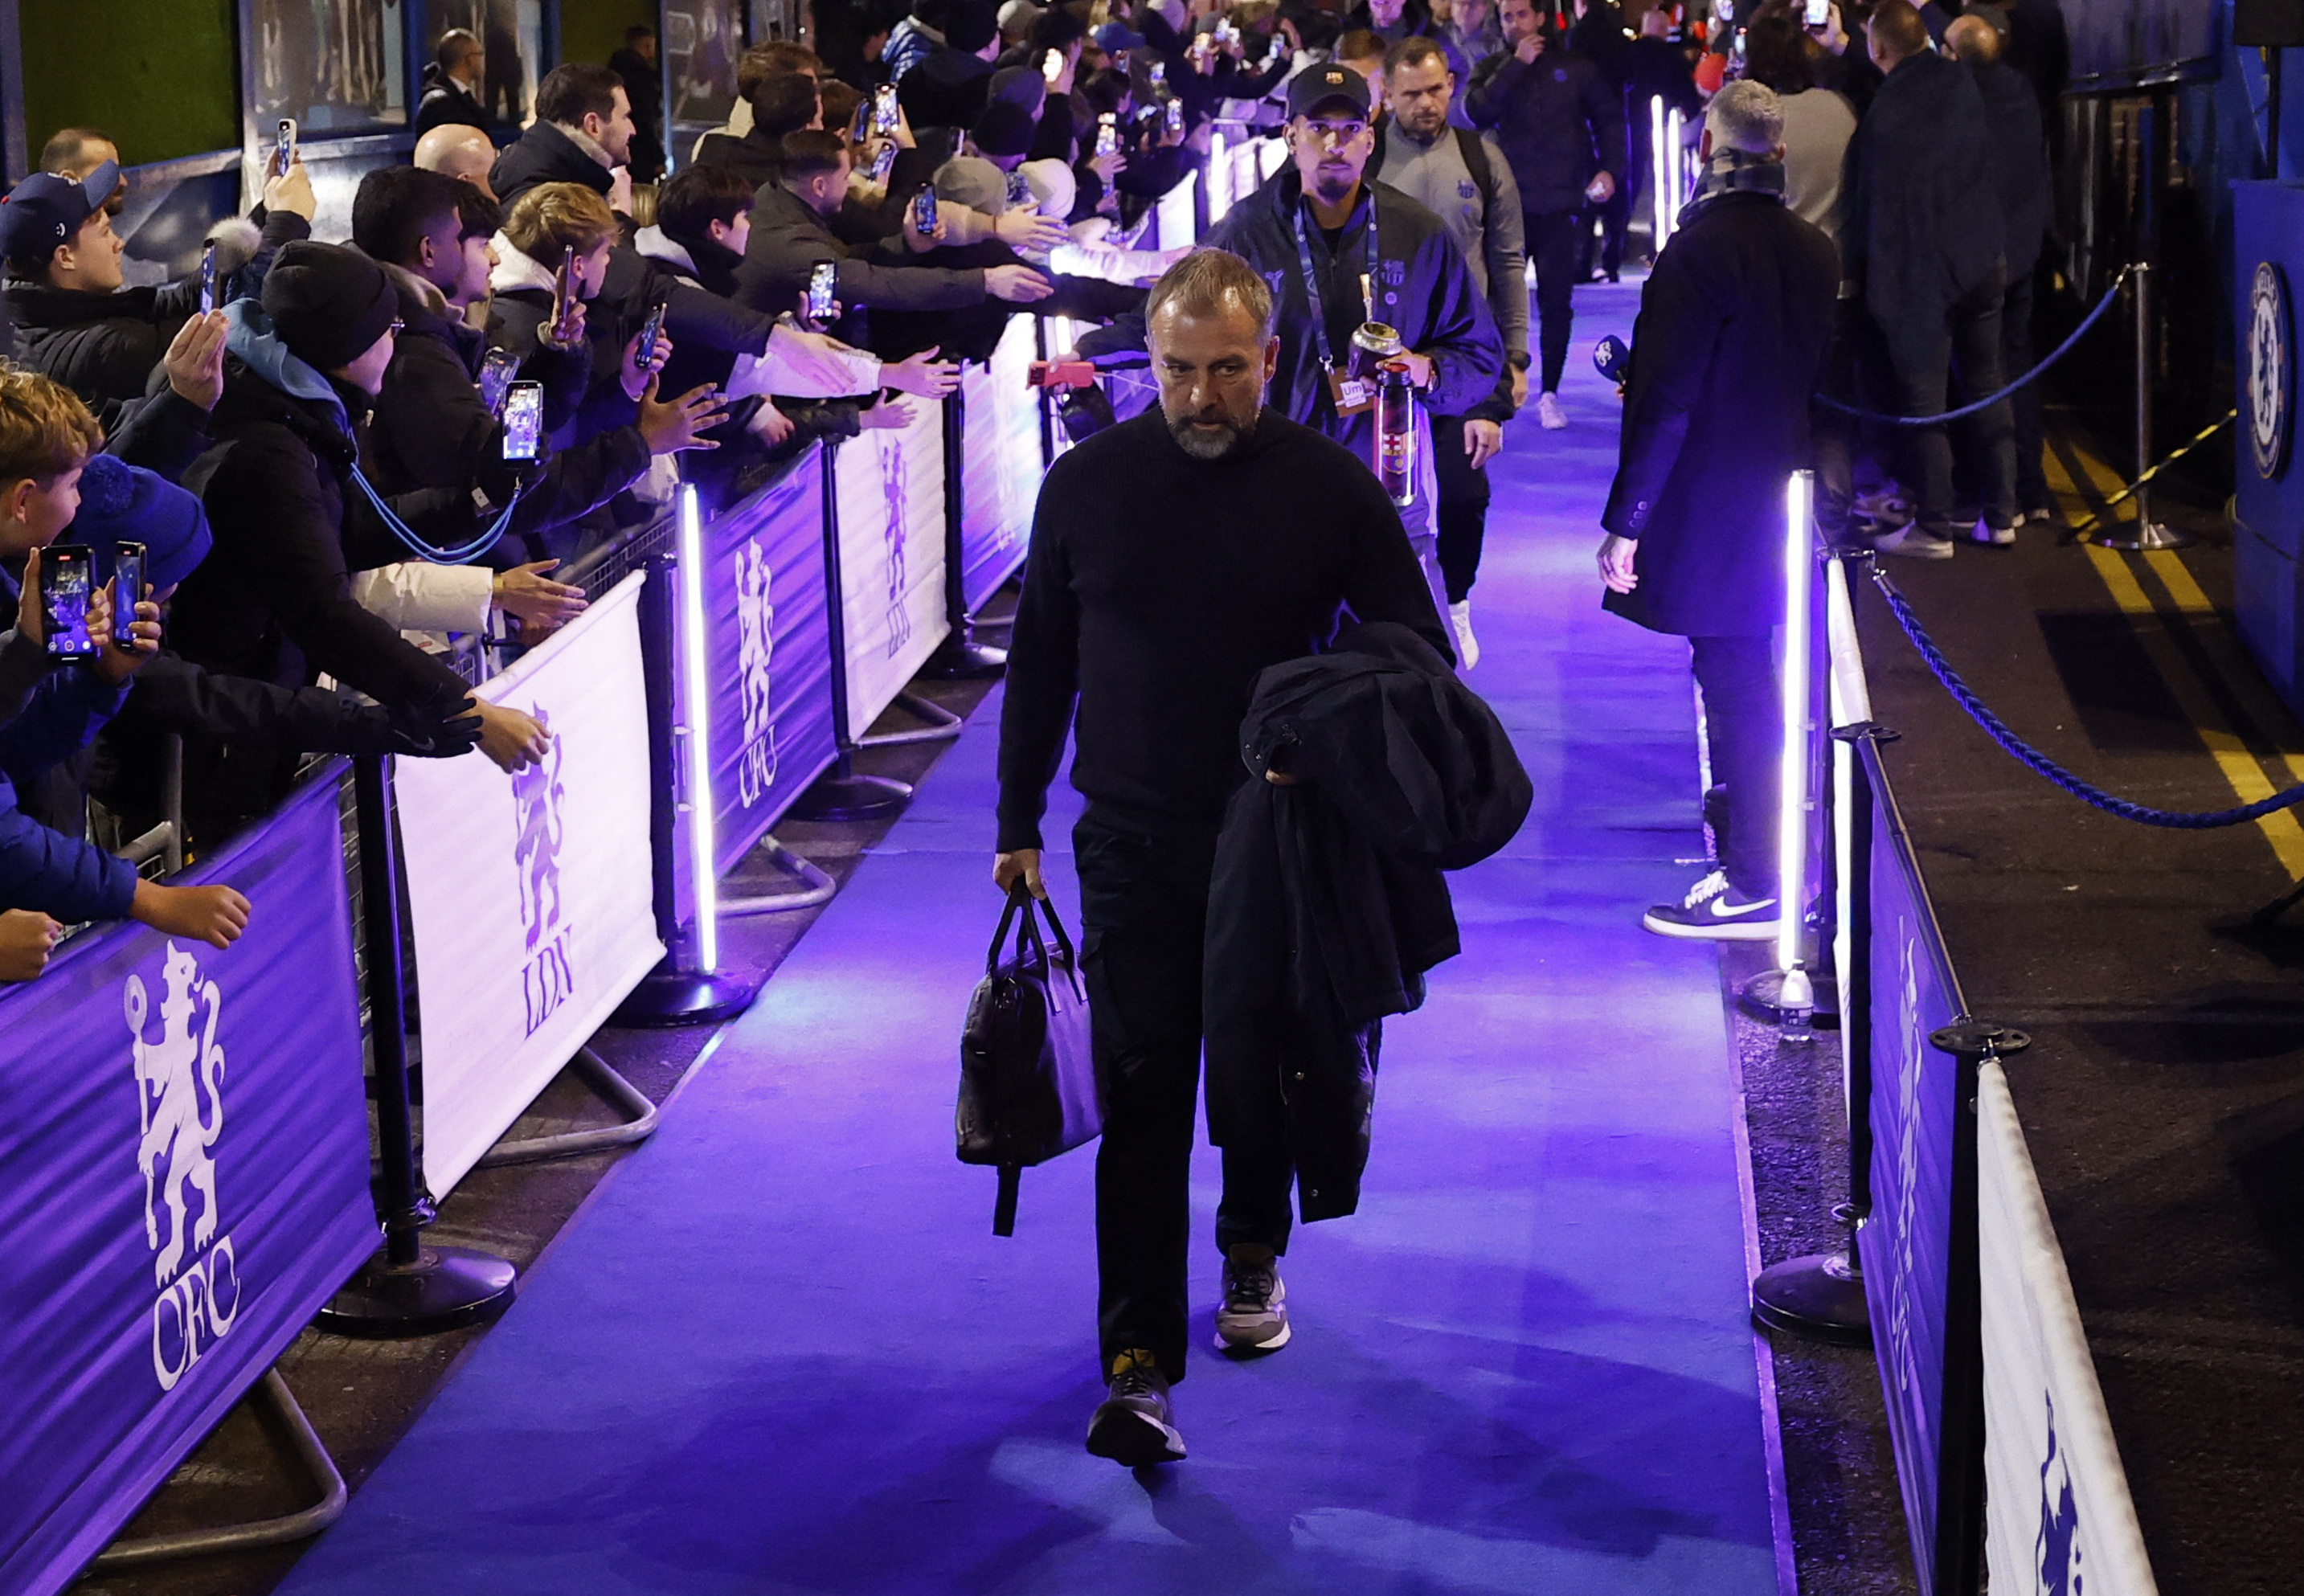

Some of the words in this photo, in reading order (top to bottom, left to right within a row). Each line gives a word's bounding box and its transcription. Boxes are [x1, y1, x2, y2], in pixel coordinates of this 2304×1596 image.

[1344, 386, 1362, 395] Um
[739, 723, 777, 809] CFC
[521, 923, 573, 1041] LDN
[153, 1234, 240, 1391] CFC
